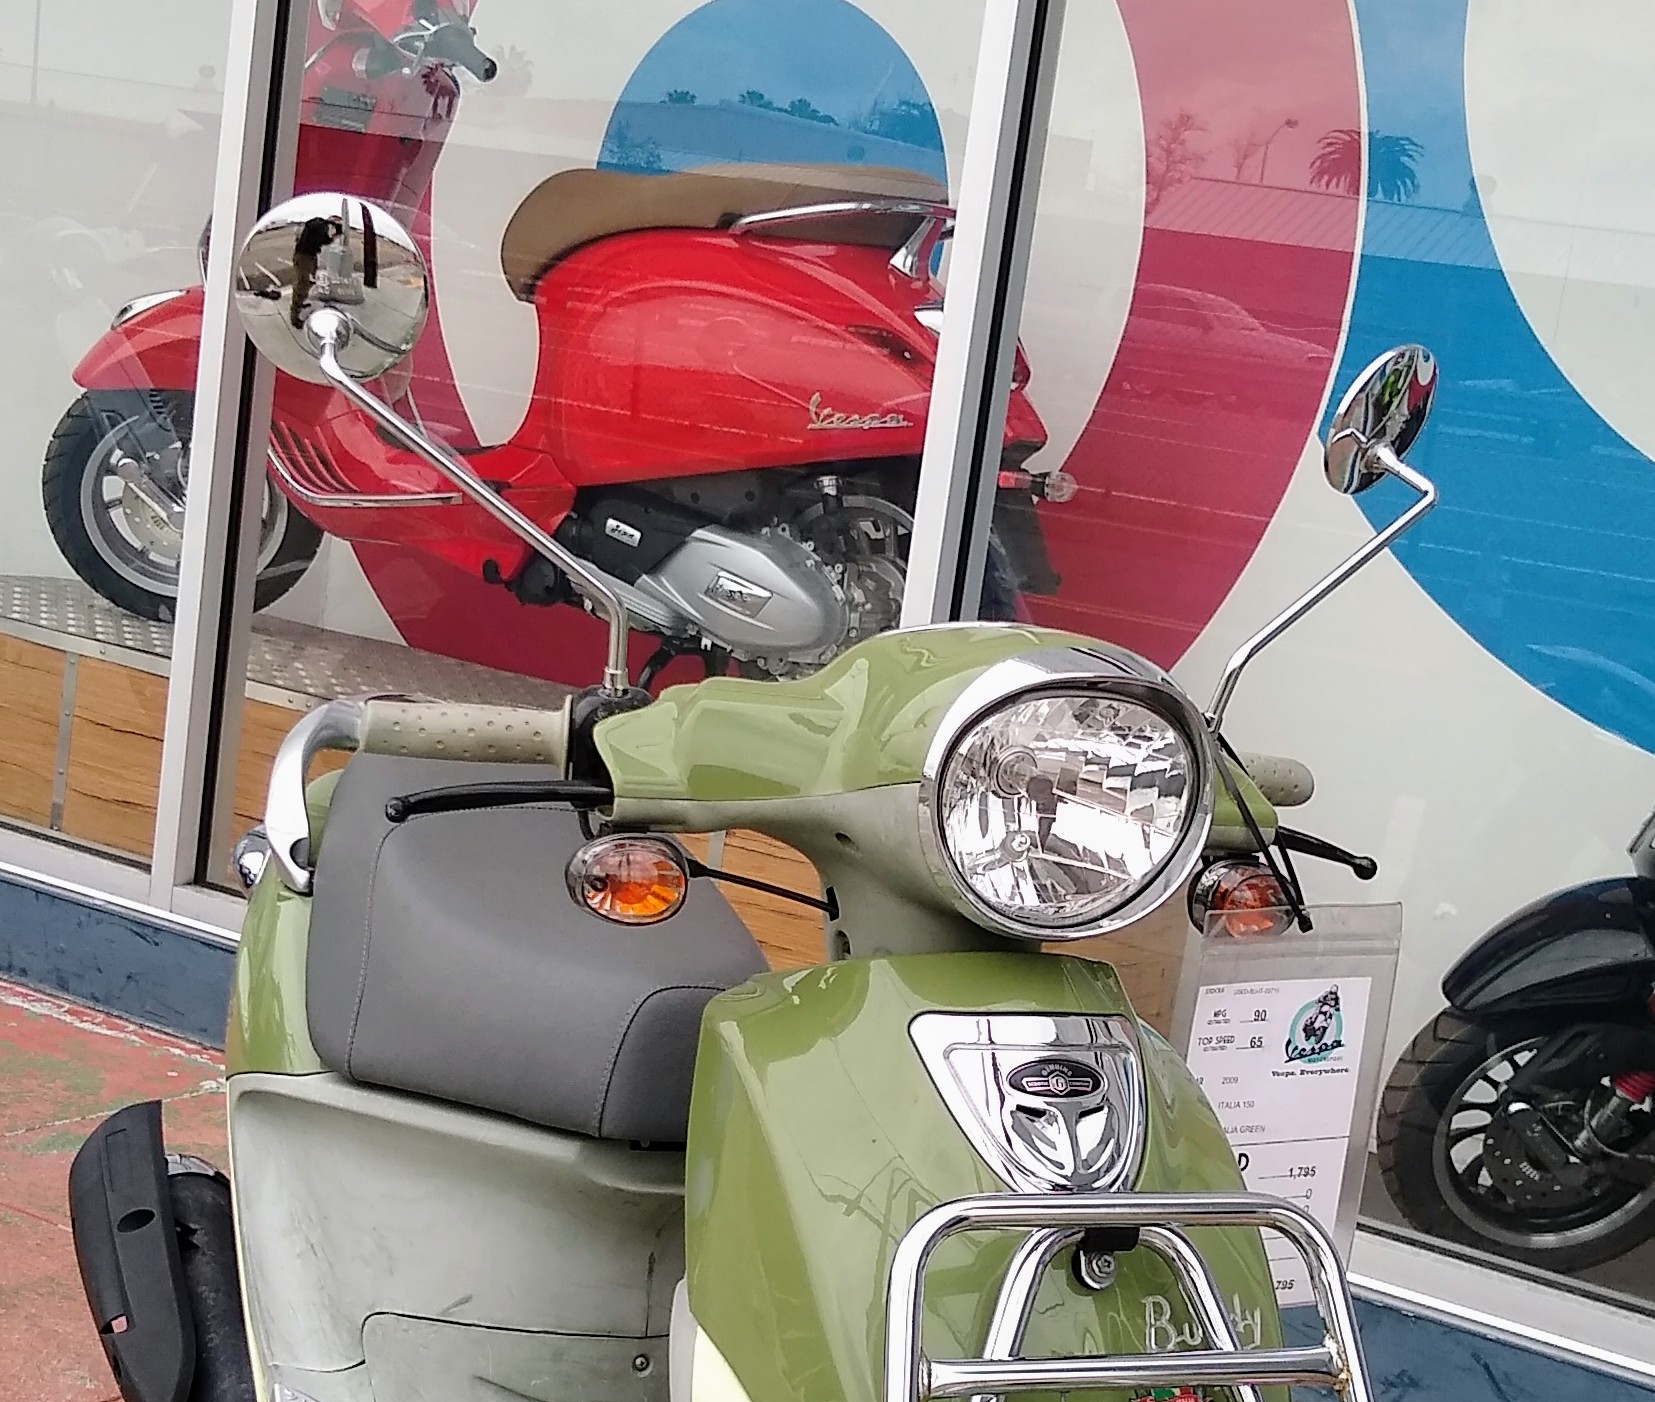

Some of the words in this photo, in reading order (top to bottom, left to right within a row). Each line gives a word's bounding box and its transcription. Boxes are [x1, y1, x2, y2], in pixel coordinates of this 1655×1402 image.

[807, 391, 914, 430] Vespa
[1253, 1009, 1267, 1022] 90
[1198, 1037, 1214, 1046] TOP
[1215, 1034, 1236, 1045] SPEED
[1250, 1036, 1264, 1049] 65
[1284, 1037, 1345, 1064] Vespa
[1299, 1067, 1350, 1076] Everywhere
[1221, 1076, 1239, 1085] 2009
[1218, 1101, 1241, 1110] ITALIA
[1240, 1124, 1266, 1134] GREEN
[1289, 1166, 1316, 1180] 1,795
